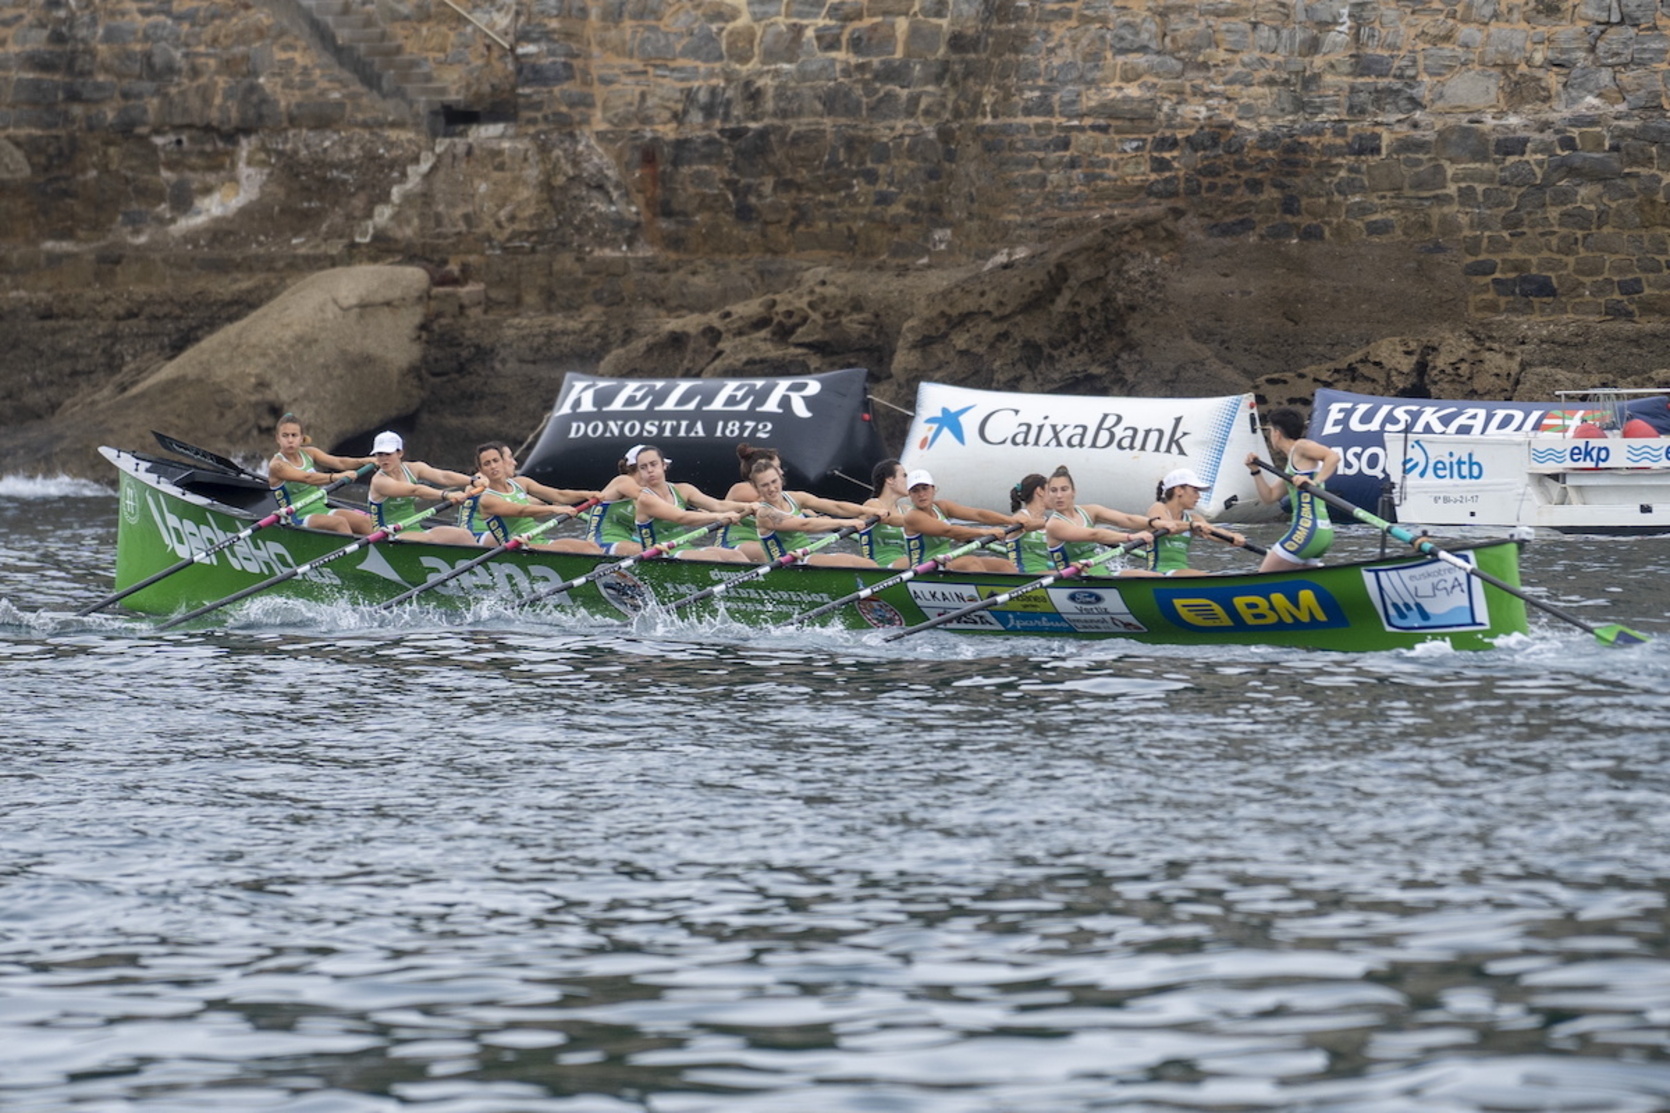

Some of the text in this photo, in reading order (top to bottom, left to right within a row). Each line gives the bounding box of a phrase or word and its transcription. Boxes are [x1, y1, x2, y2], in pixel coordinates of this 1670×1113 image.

[555, 379, 822, 418] KELER
[568, 420, 773, 439] DONOSTIA 1872
[978, 407, 1192, 456] CaixaBank
[1321, 403, 1545, 435] EUSKADI
[1432, 451, 1483, 480] eitb
[1569, 441, 1610, 467] ekp
[1409, 566, 1457, 582] euskotre
[1415, 577, 1465, 598] LIGA
[913, 590, 967, 603] ALKAIN
[1232, 589, 1328, 625] BM
